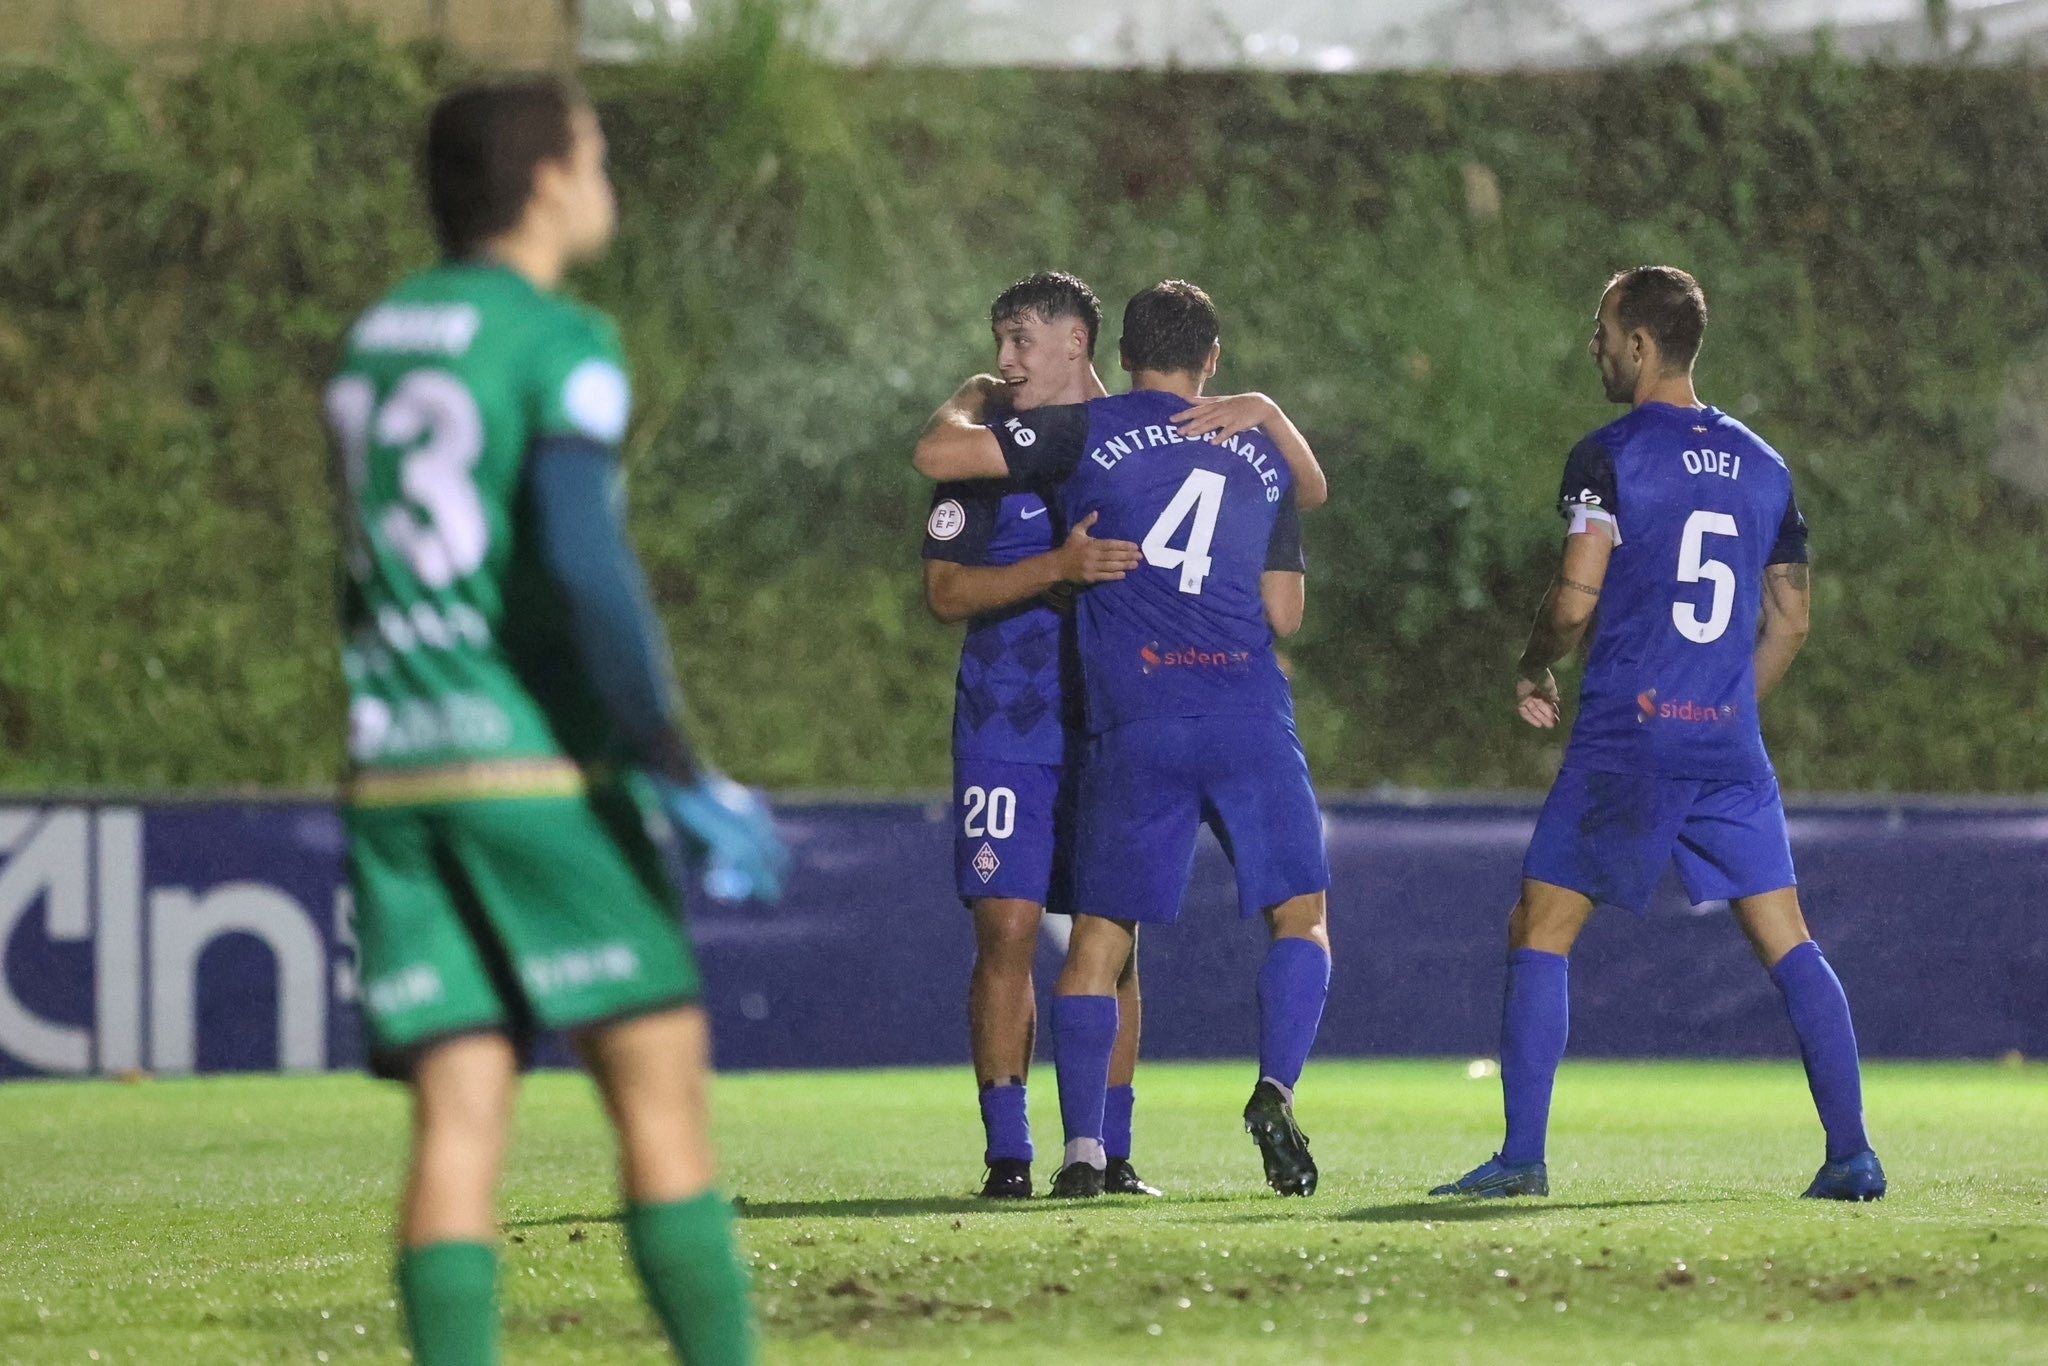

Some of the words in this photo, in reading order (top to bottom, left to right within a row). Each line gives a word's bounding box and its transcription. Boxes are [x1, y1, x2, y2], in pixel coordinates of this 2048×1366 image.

[1682, 448, 1741, 480] ODEI
[1141, 468, 1226, 595] 4
[1672, 510, 1739, 643] 5
[963, 785, 1017, 839] 20
